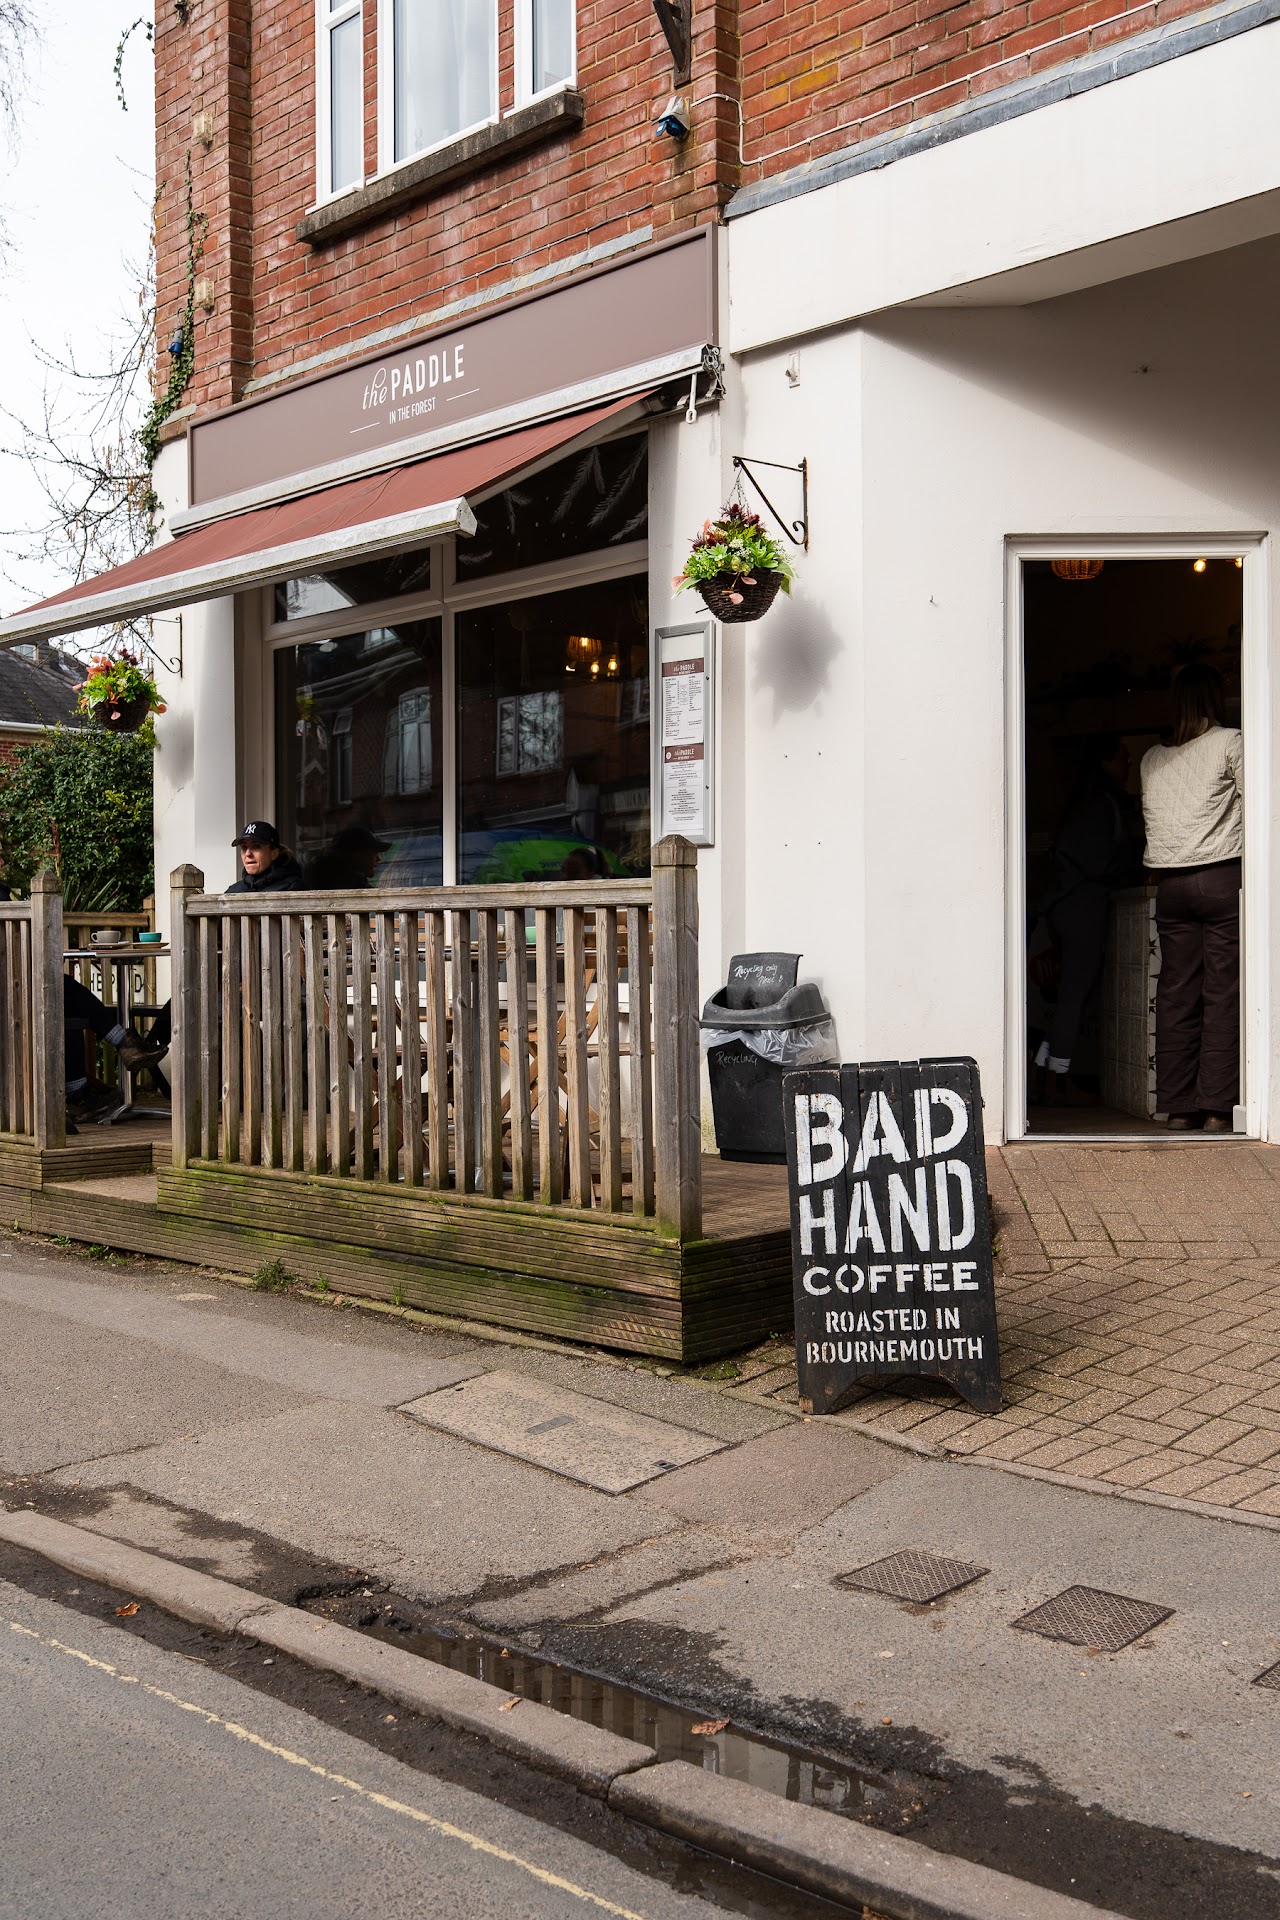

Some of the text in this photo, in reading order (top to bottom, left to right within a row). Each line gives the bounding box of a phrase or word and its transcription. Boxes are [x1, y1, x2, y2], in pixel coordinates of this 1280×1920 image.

[362, 344, 465, 410] the PADDLE
[389, 396, 436, 425] IN THE FOREST
[734, 964, 764, 980] Recycling
[794, 1087, 969, 1187] BAD
[798, 1159, 976, 1256] HAND
[802, 1261, 979, 1297] COFFEE
[825, 1306, 960, 1333] ROASTED IN
[806, 1336, 984, 1364] BOURNEMOUTH
